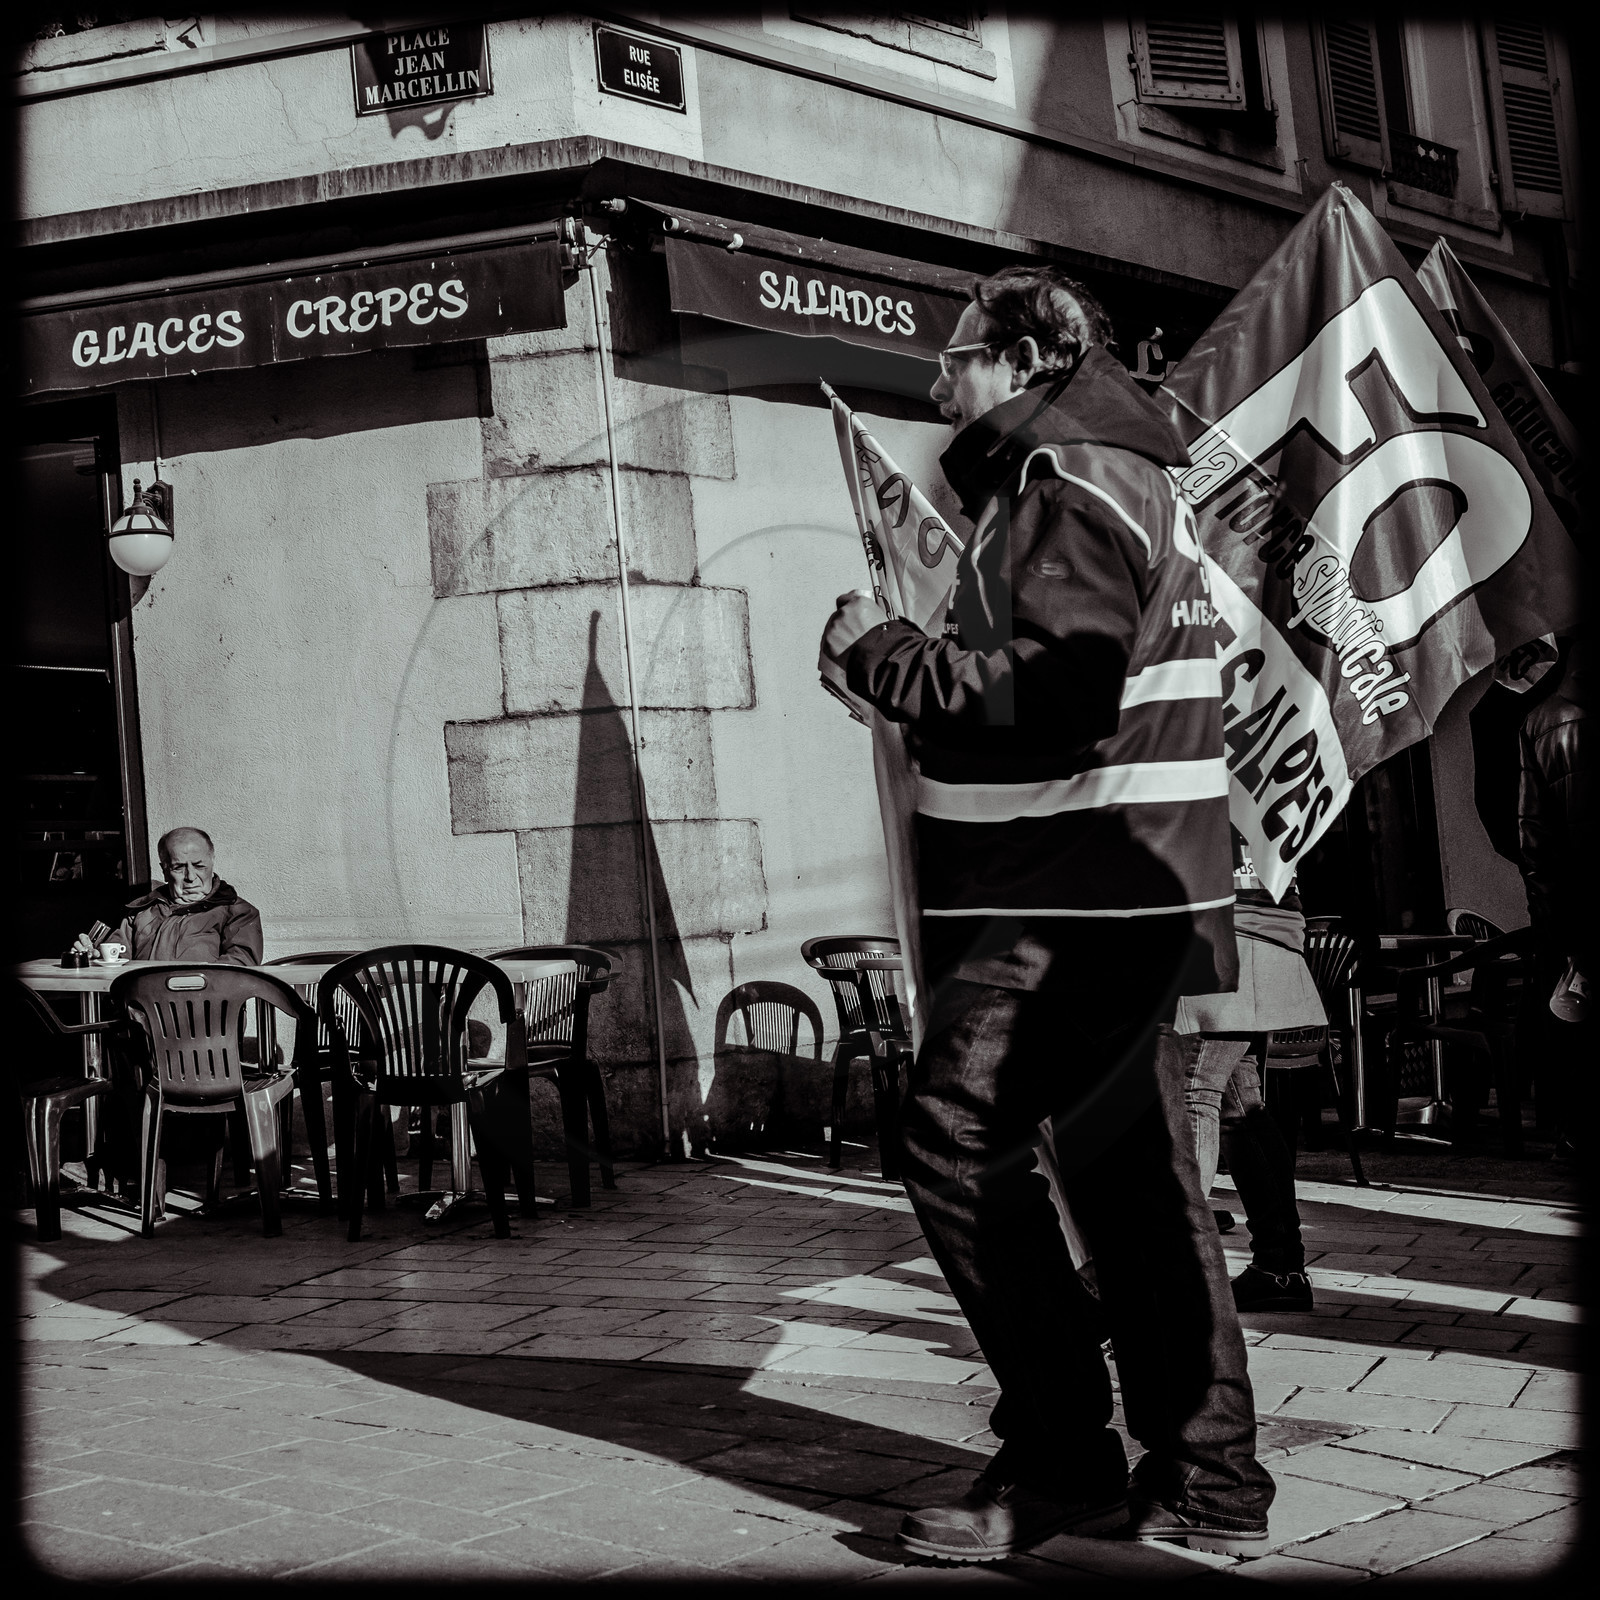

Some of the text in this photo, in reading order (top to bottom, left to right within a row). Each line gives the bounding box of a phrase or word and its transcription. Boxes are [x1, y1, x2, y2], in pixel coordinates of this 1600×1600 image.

[387, 28, 450, 55] PLACE
[629, 45, 652, 66] RUE
[394, 51, 445, 76] JEAN
[365, 69, 480, 106] MARCELLIN
[623, 68, 661, 94] ELISÉE
[758, 270, 917, 336] SALADES
[71, 279, 470, 368] GLACES CREPES
[1168, 429, 1238, 500] la
